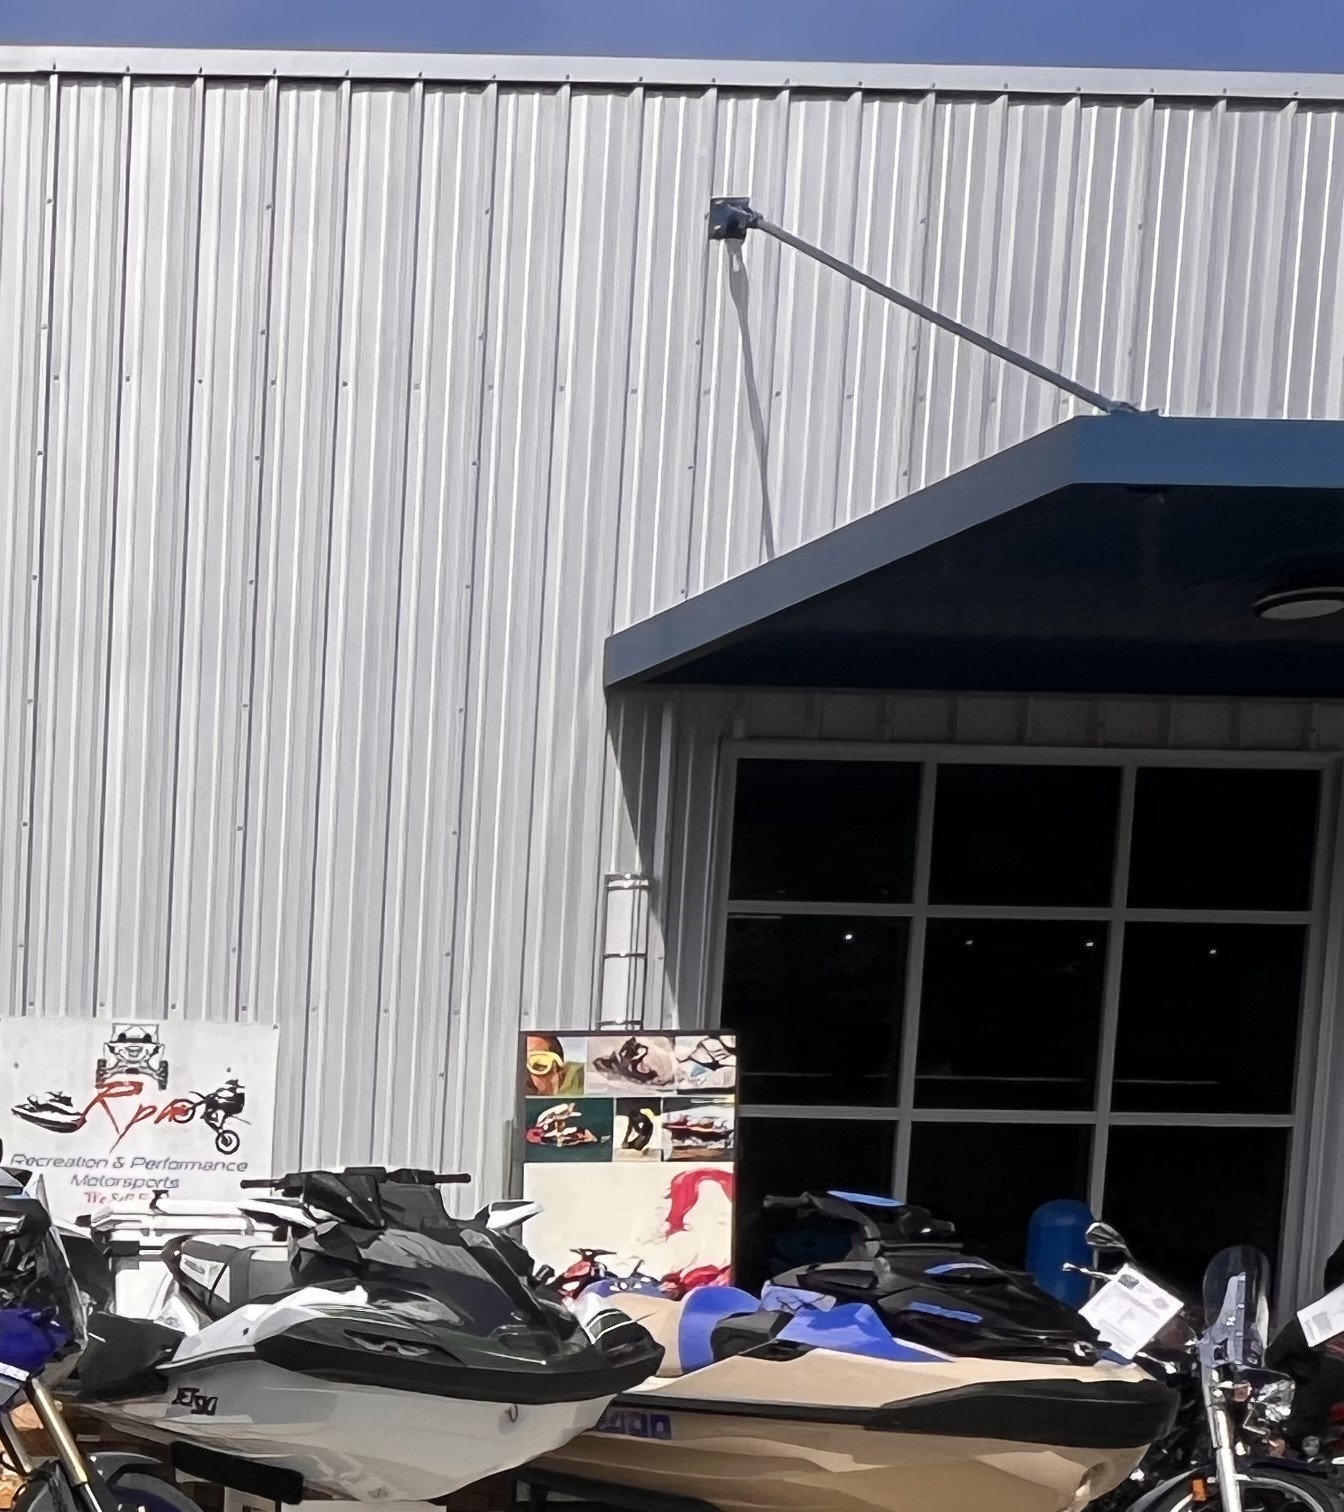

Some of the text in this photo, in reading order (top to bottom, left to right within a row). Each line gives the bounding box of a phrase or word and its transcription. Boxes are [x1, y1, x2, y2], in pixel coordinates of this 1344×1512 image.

[9, 1153, 249, 1172] Recreation & Performance
[69, 1173, 180, 1190] Motorsports
